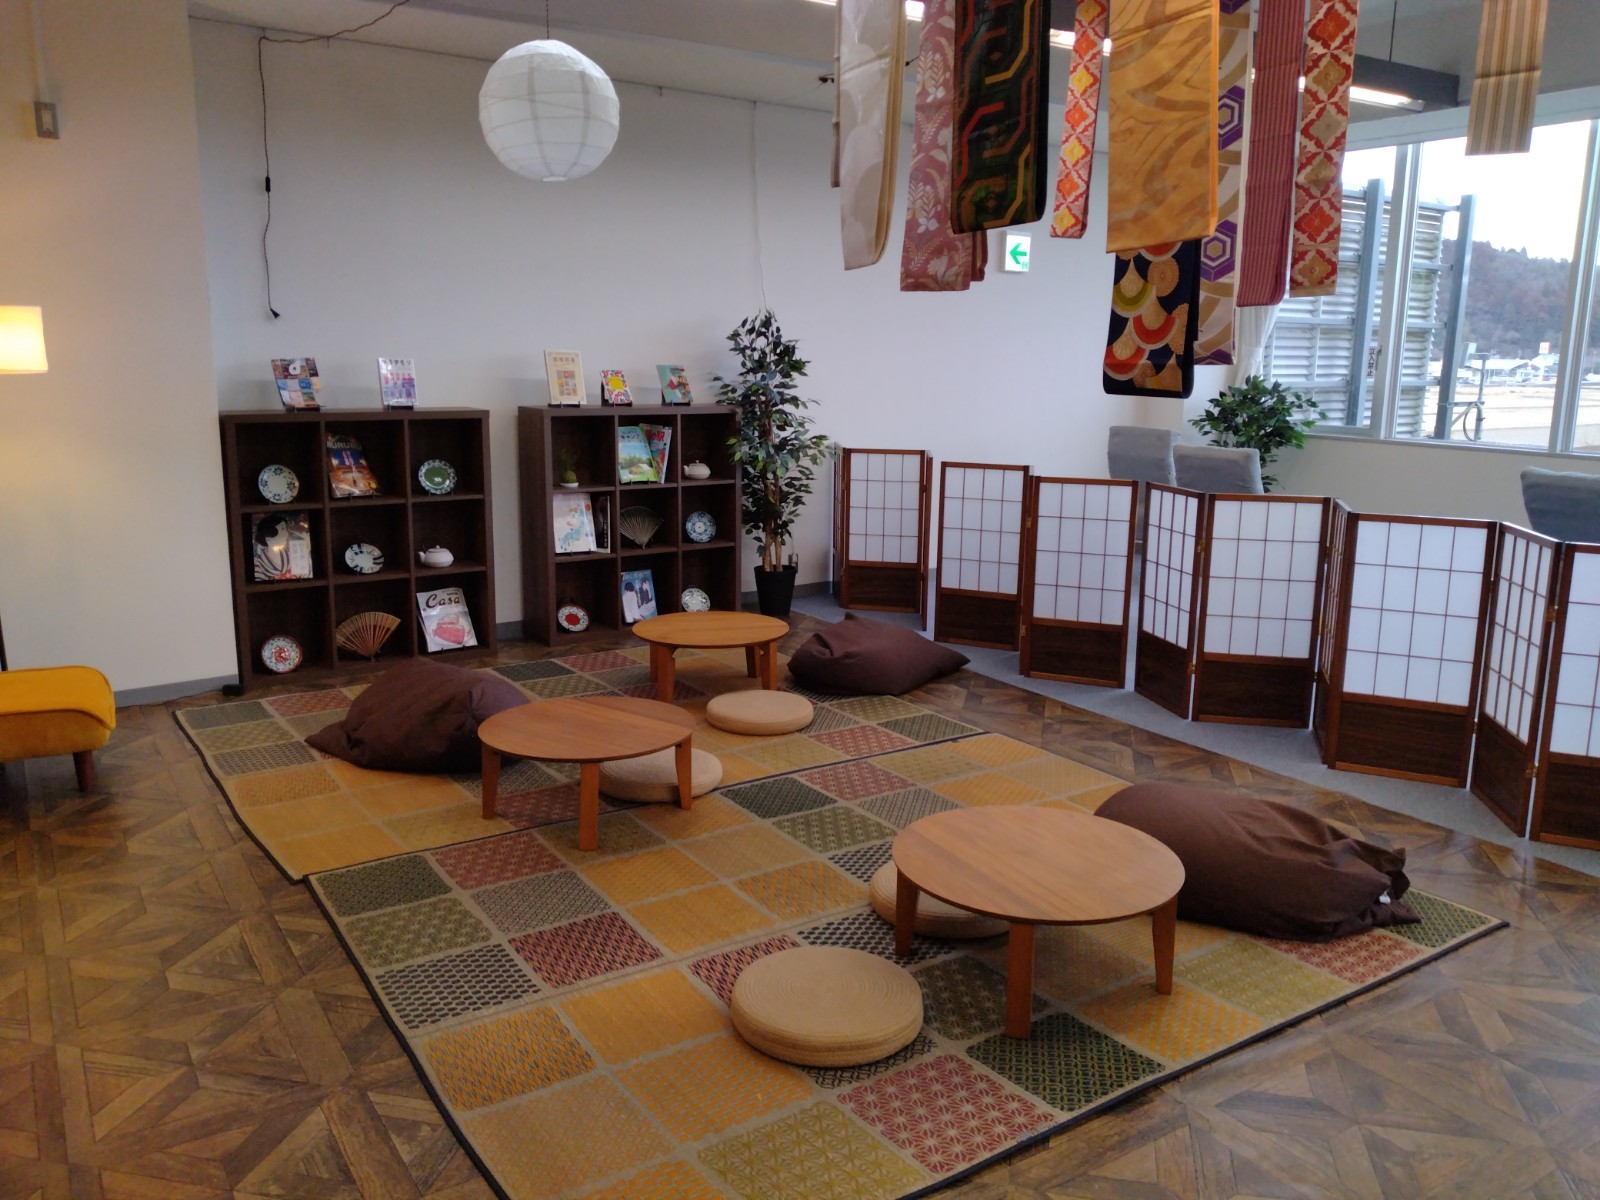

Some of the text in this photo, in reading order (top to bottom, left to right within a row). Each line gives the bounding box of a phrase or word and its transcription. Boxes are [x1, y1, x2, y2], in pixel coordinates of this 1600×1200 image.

[1367, 348, 1375, 376] 立入禁止
[425, 594, 460, 609] Casa
